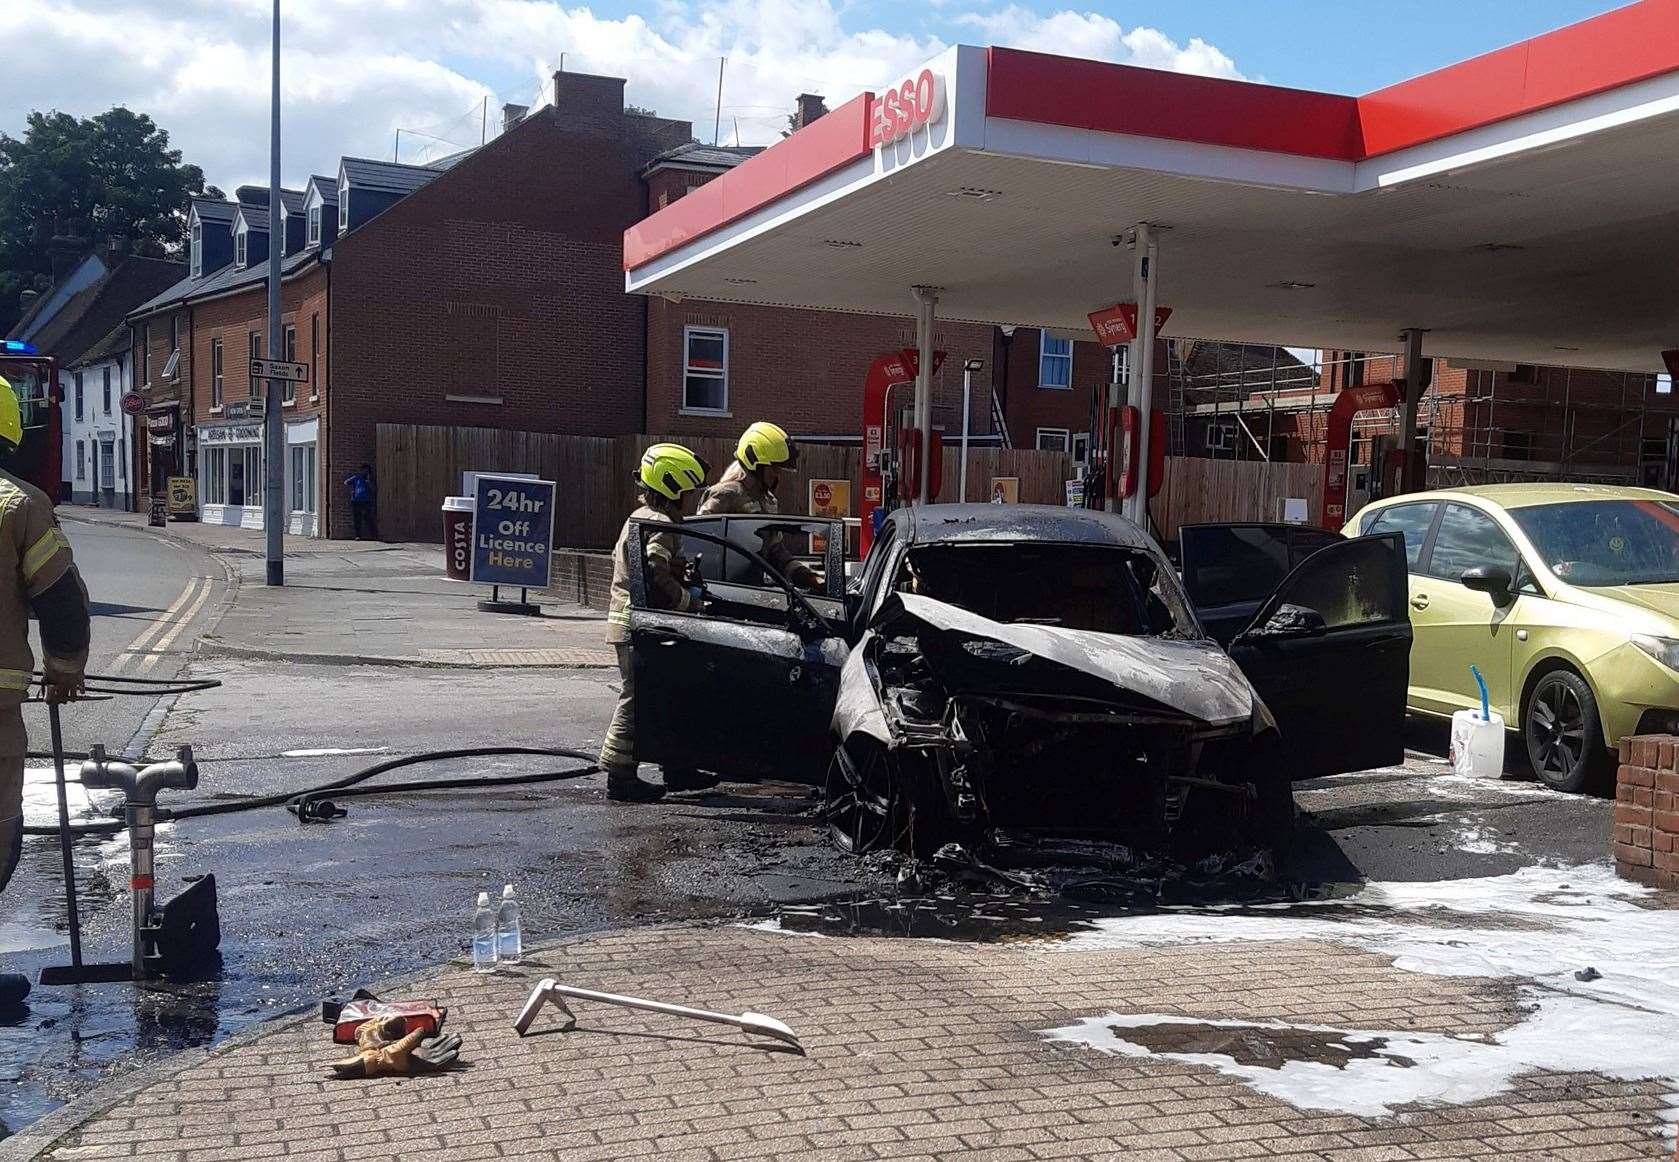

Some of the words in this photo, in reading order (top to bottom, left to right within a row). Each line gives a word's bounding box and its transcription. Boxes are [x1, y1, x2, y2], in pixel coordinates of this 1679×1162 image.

[869, 68, 935, 149] ESSO
[487, 489, 544, 513] 24hr
[498, 520, 530, 537] Off
[454, 522, 467, 570] COSTA
[480, 533, 546, 554] Licence
[489, 551, 533, 569] Here
